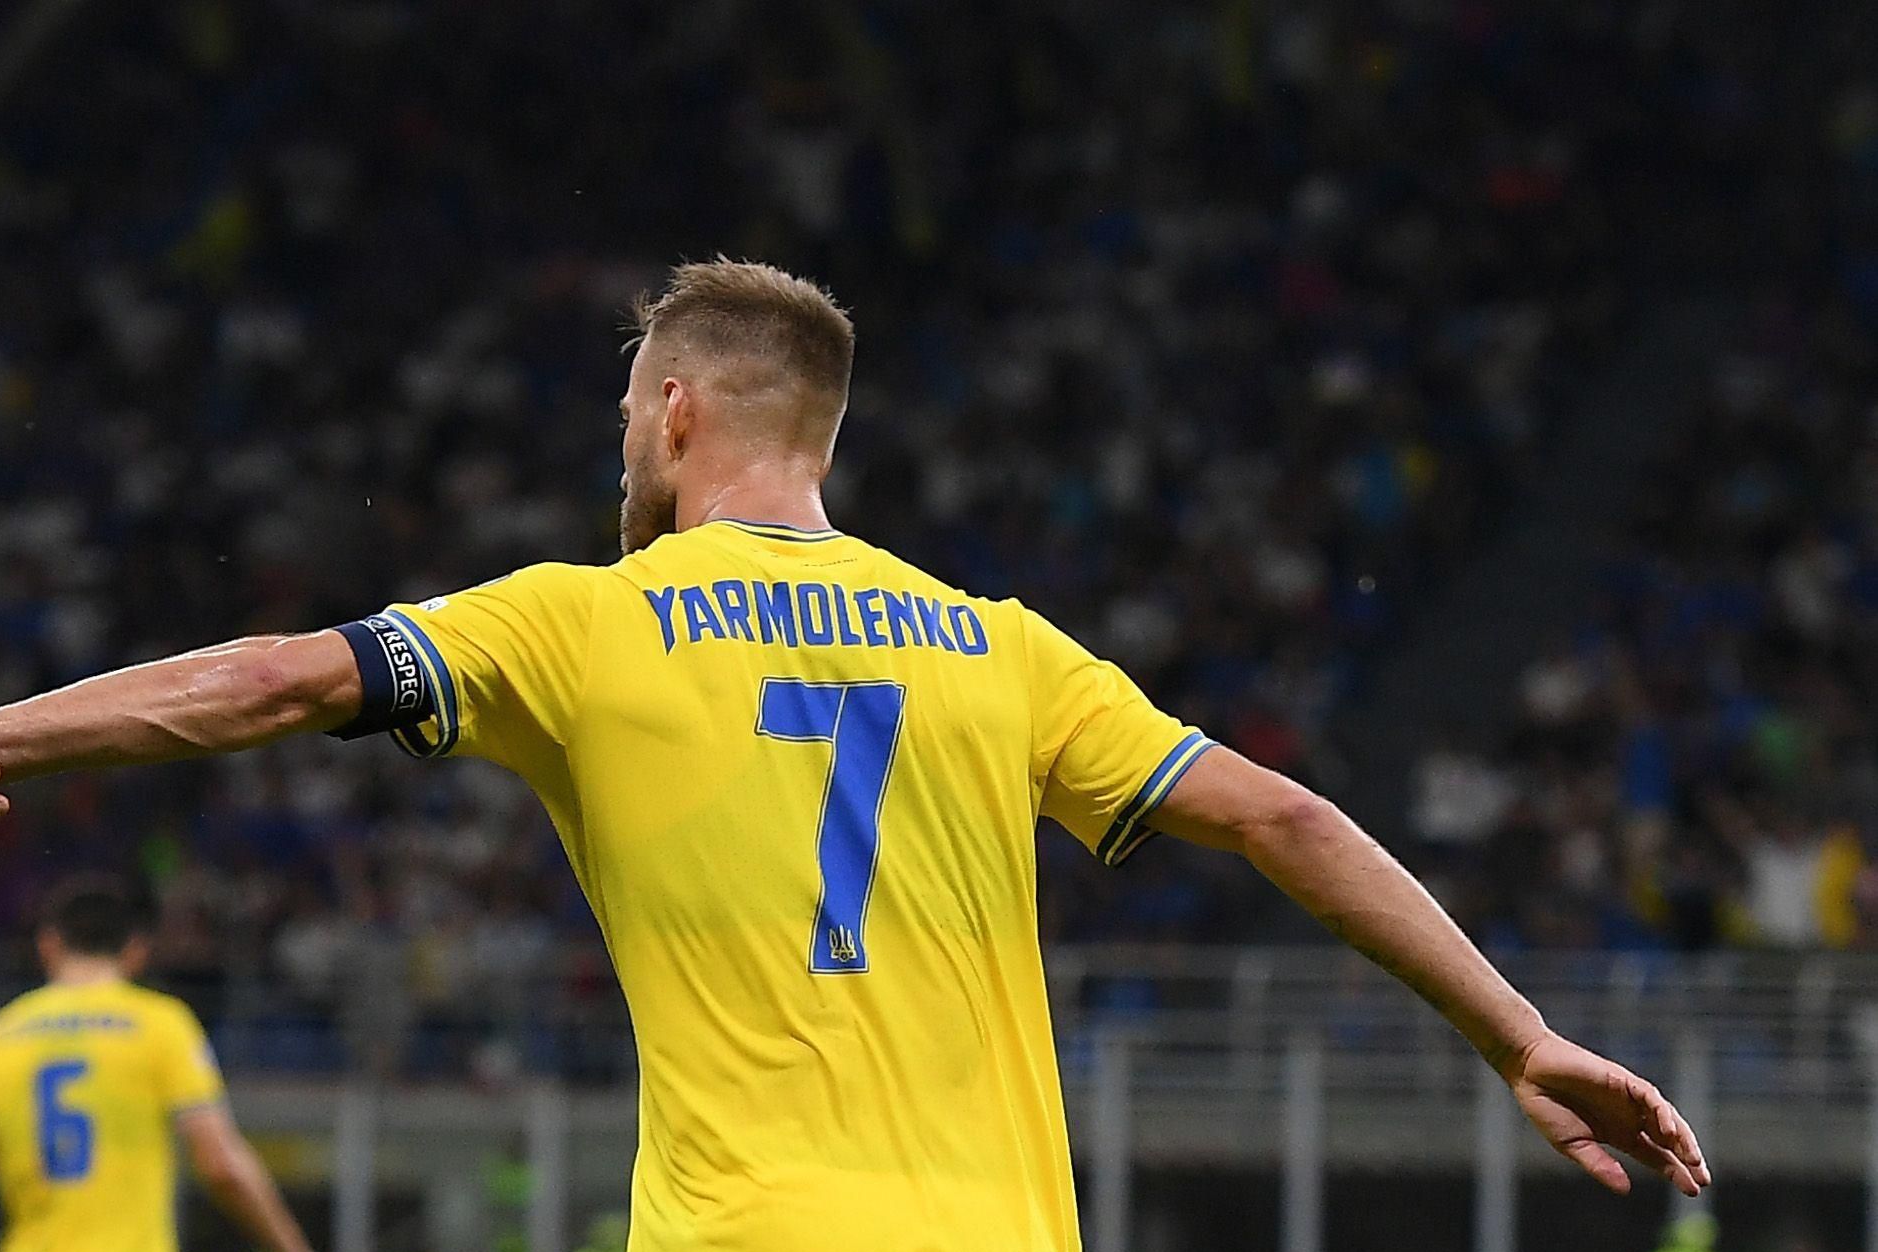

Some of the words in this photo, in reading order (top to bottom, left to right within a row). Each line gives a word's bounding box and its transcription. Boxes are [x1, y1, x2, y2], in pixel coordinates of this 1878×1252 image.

[643, 578, 990, 656] YARMOLENKO
[383, 629, 419, 710] RESPEC
[754, 675, 908, 974] 7
[32, 1058, 96, 1184] 6
